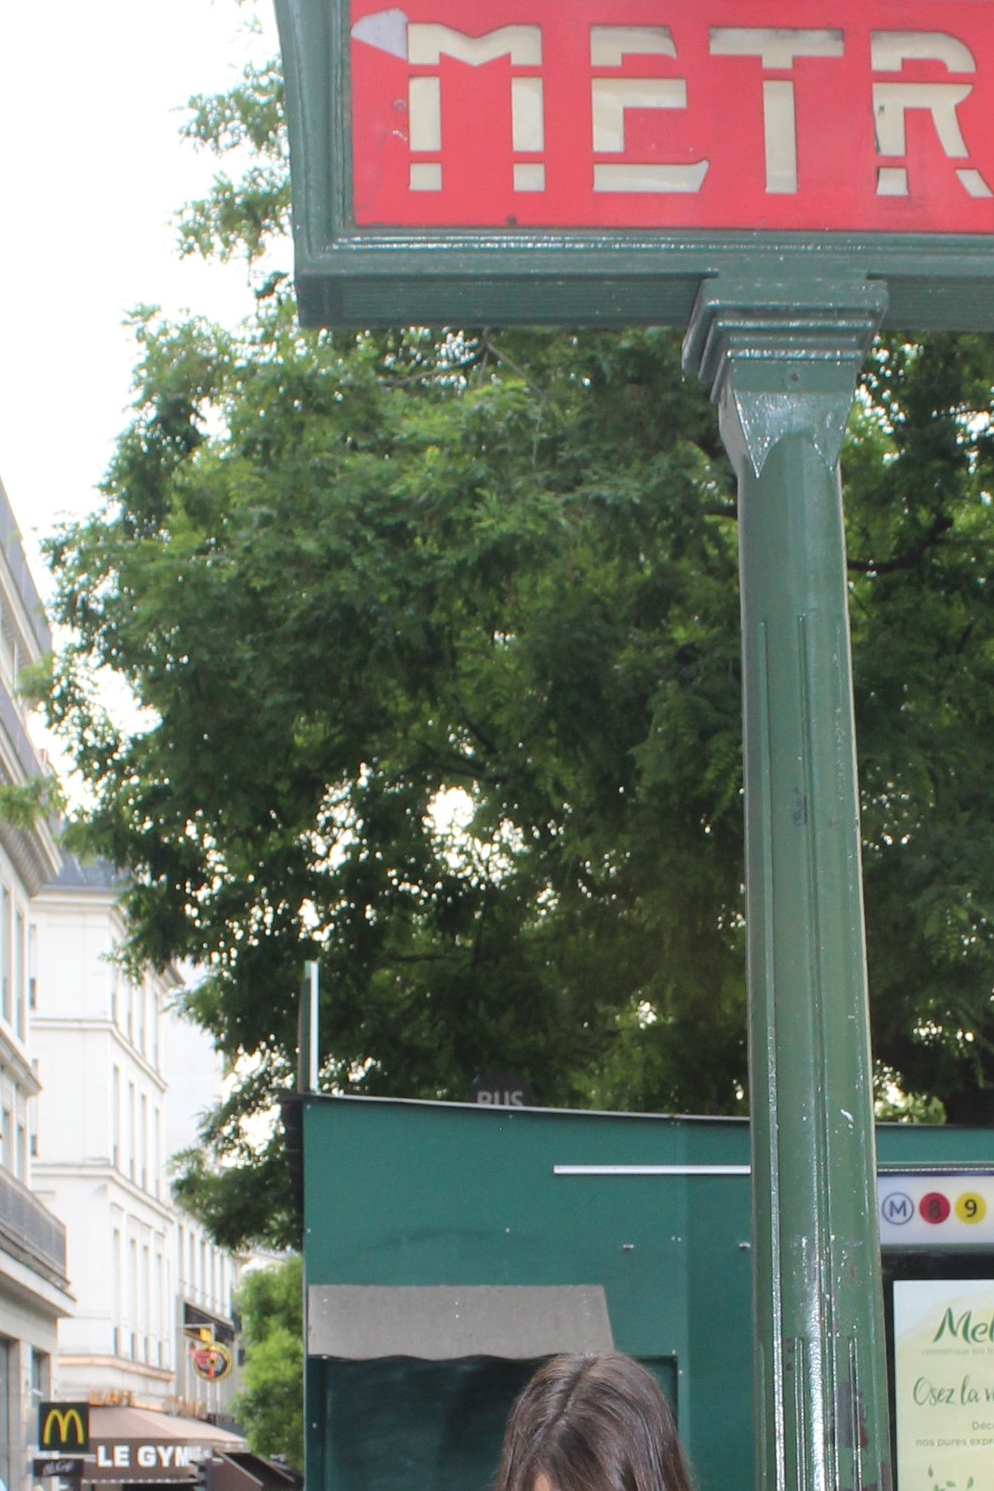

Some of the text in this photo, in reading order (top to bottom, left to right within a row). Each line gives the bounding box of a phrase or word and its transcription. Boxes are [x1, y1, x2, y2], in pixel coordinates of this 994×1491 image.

[477, 1090, 524, 1106] BUS
[929, 1200, 941, 1218] 8
[964, 1199, 978, 1217] 9
[961, 1375, 980, 1405] la
[915, 1438, 935, 1446] nos
[937, 1437, 966, 1448] pures
[97, 1445, 130, 1468] LE
